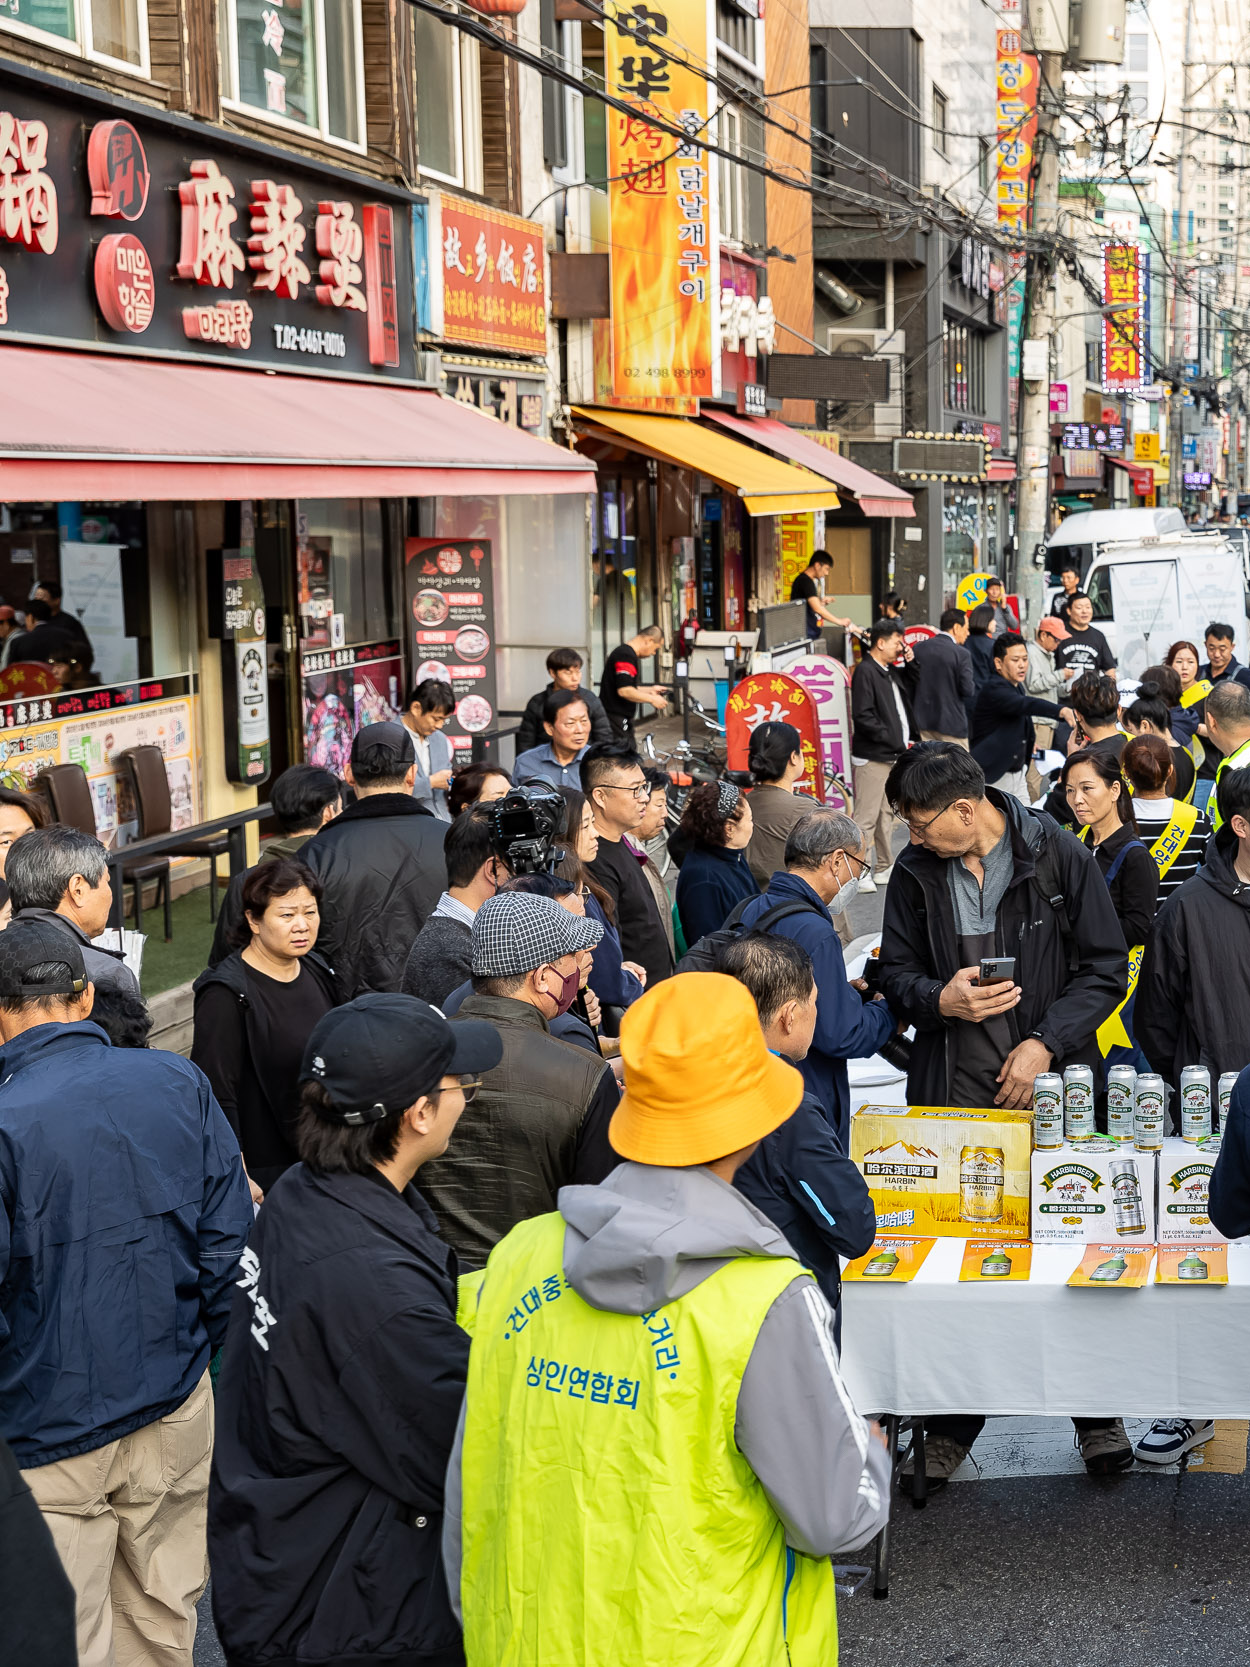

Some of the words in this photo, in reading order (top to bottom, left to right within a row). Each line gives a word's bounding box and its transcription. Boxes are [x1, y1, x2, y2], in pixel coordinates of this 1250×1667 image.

[198, 300, 254, 350] 마라탕
[624, 366, 643, 379] 02
[645, 366, 670, 379] 498
[673, 366, 707, 379] 8999
[867, 1163, 935, 1177] 哈尔滨啤酒
[884, 1177, 917, 1185] HARBIN
[1049, 1205, 1096, 1213] 哈尔滨啤酒
[526, 1355, 641, 1411] 상인연합회
